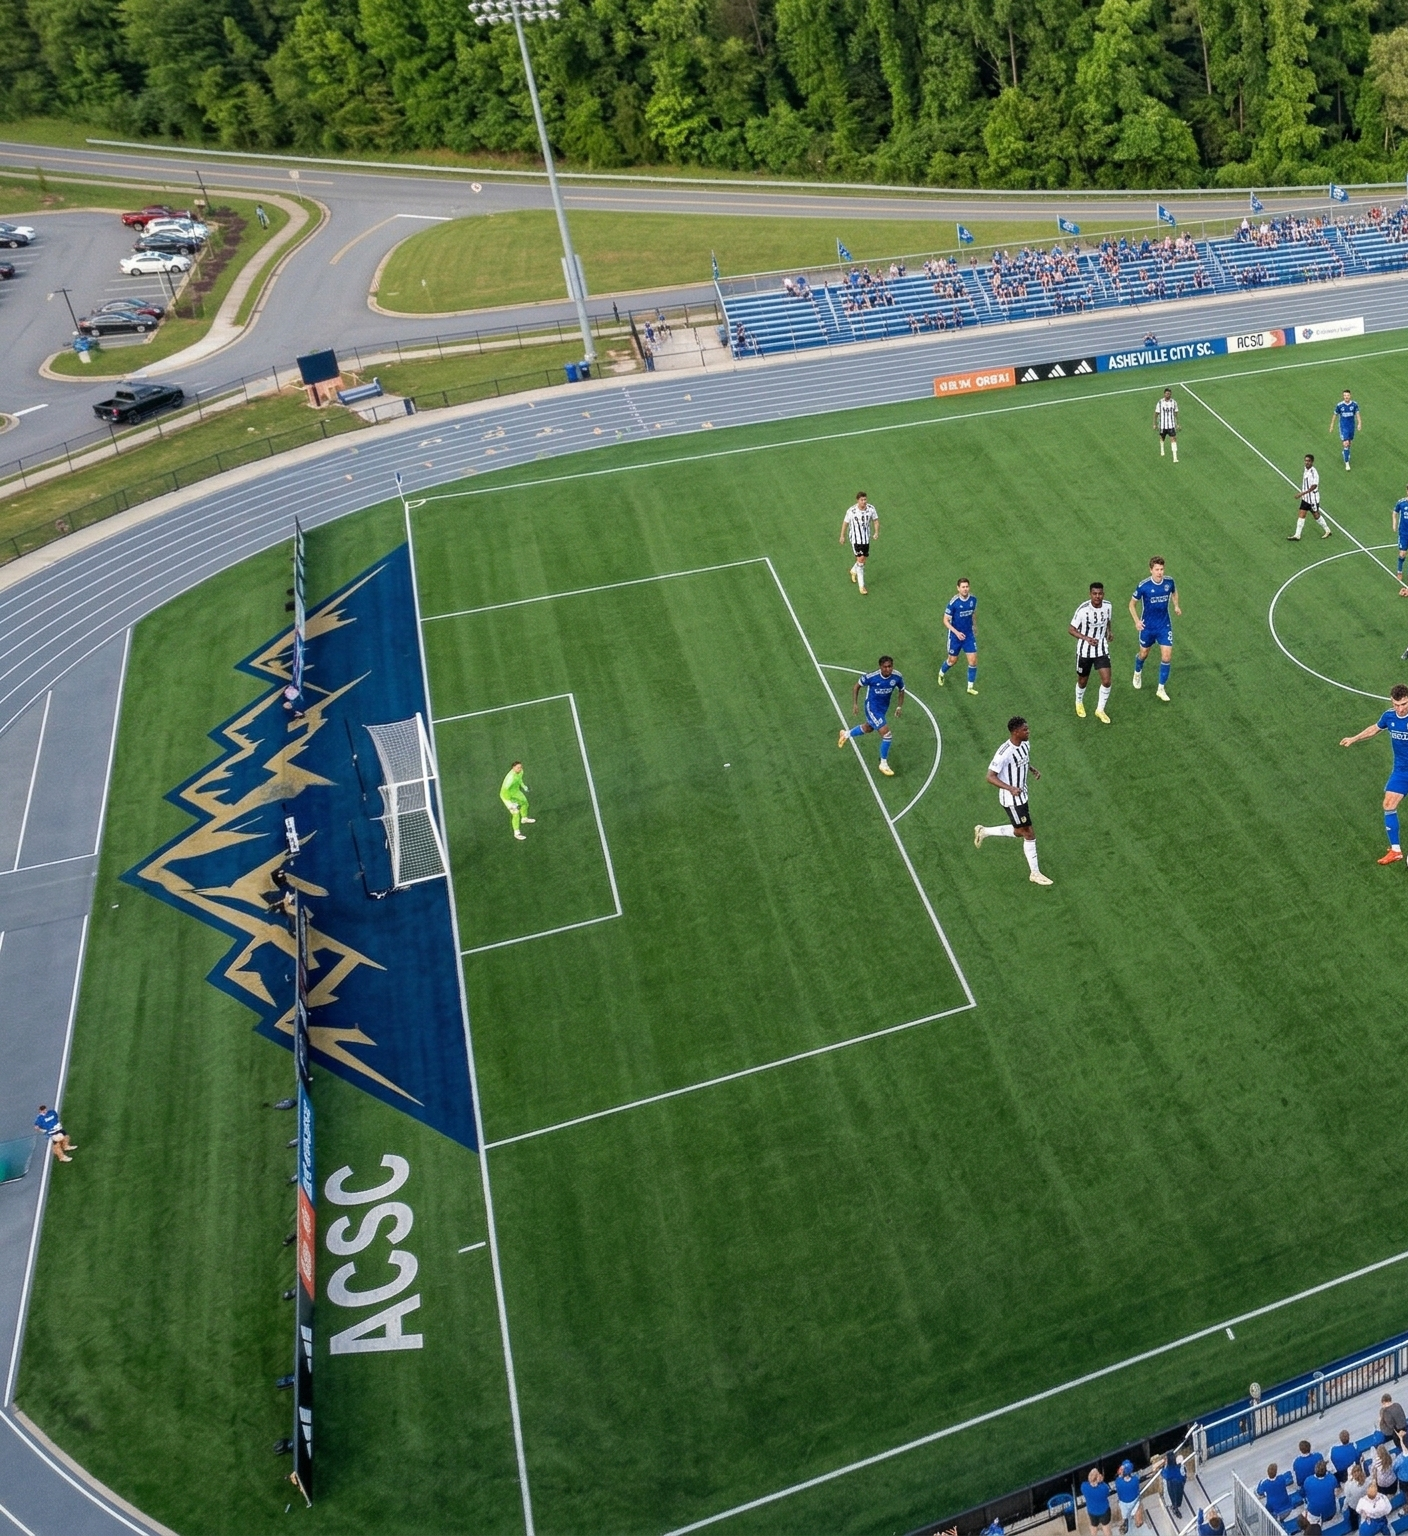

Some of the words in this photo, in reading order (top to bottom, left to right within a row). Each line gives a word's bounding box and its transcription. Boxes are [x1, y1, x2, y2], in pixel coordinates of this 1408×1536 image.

[1108, 349, 1168, 370] ASHEVILLE
[1169, 345, 1196, 361] CITY
[1196, 342, 1215, 356] SC.
[324, 1153, 424, 1356] ACSC
